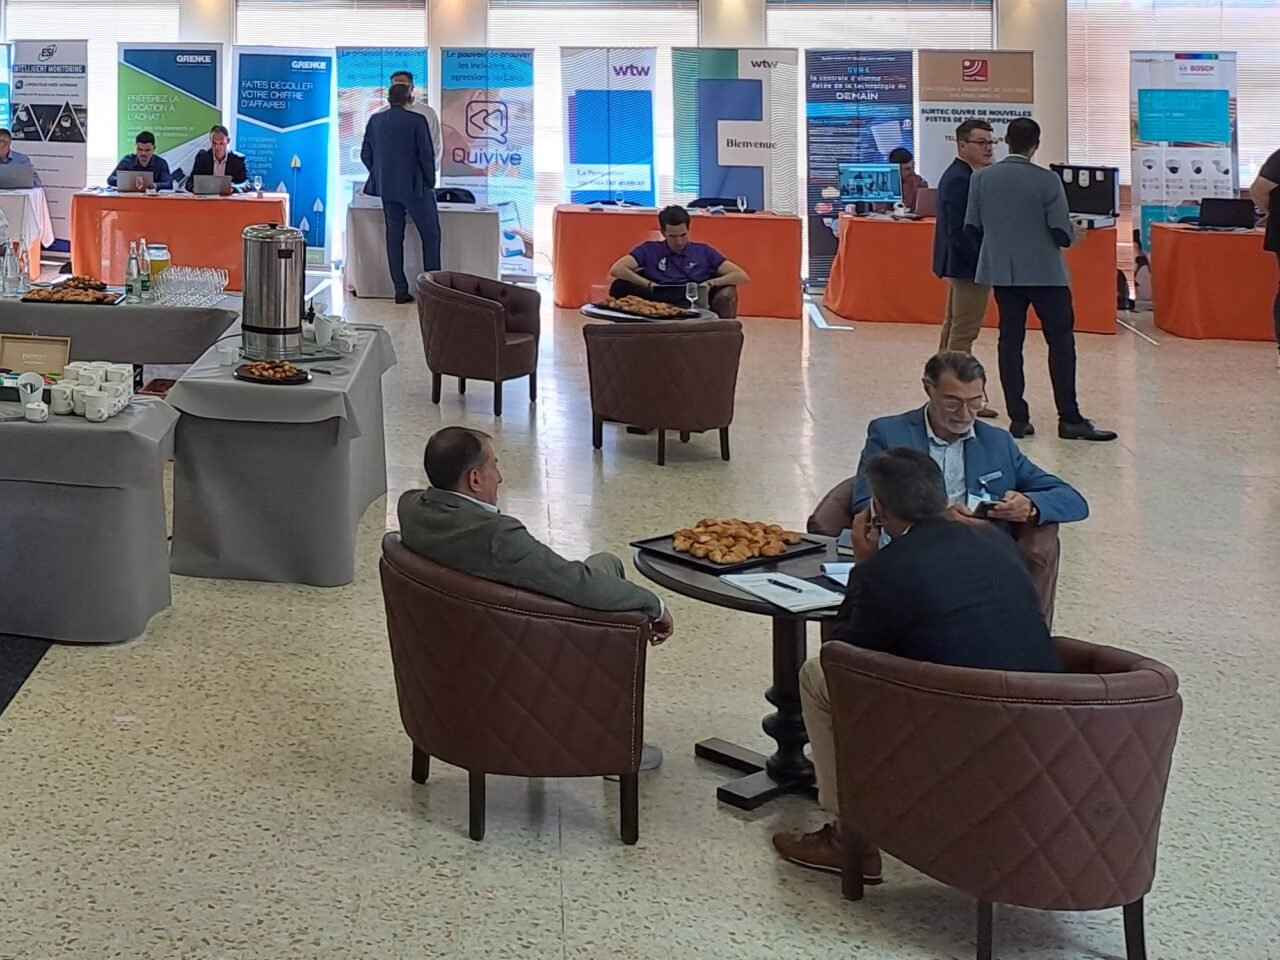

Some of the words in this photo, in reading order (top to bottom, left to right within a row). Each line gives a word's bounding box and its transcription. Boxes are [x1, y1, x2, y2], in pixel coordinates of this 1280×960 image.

[41, 47, 54, 57] ESI
[176, 54, 211, 63] GRENKE
[48, 65, 83, 73] MONITORING
[291, 60, 327, 69] GRENKE
[750, 60, 779, 69] wtw
[613, 64, 651, 76] wtw
[241, 80, 269, 89] FAITES
[270, 80, 314, 90] DÉCOLLER
[241, 90, 268, 99] VOTRE
[270, 91, 304, 100] CHIFFRE
[836, 92, 878, 100] DEMAIN
[127, 104, 167, 112] LOCATION
[241, 100, 286, 109] D'AFFAIRES
[127, 113, 160, 121] L'ACHAT
[951, 108, 976, 116] OUVRE
[989, 109, 1032, 117] NOUVELLES
[726, 139, 777, 149] Bienvenue
[453, 148, 522, 165] Quivive
